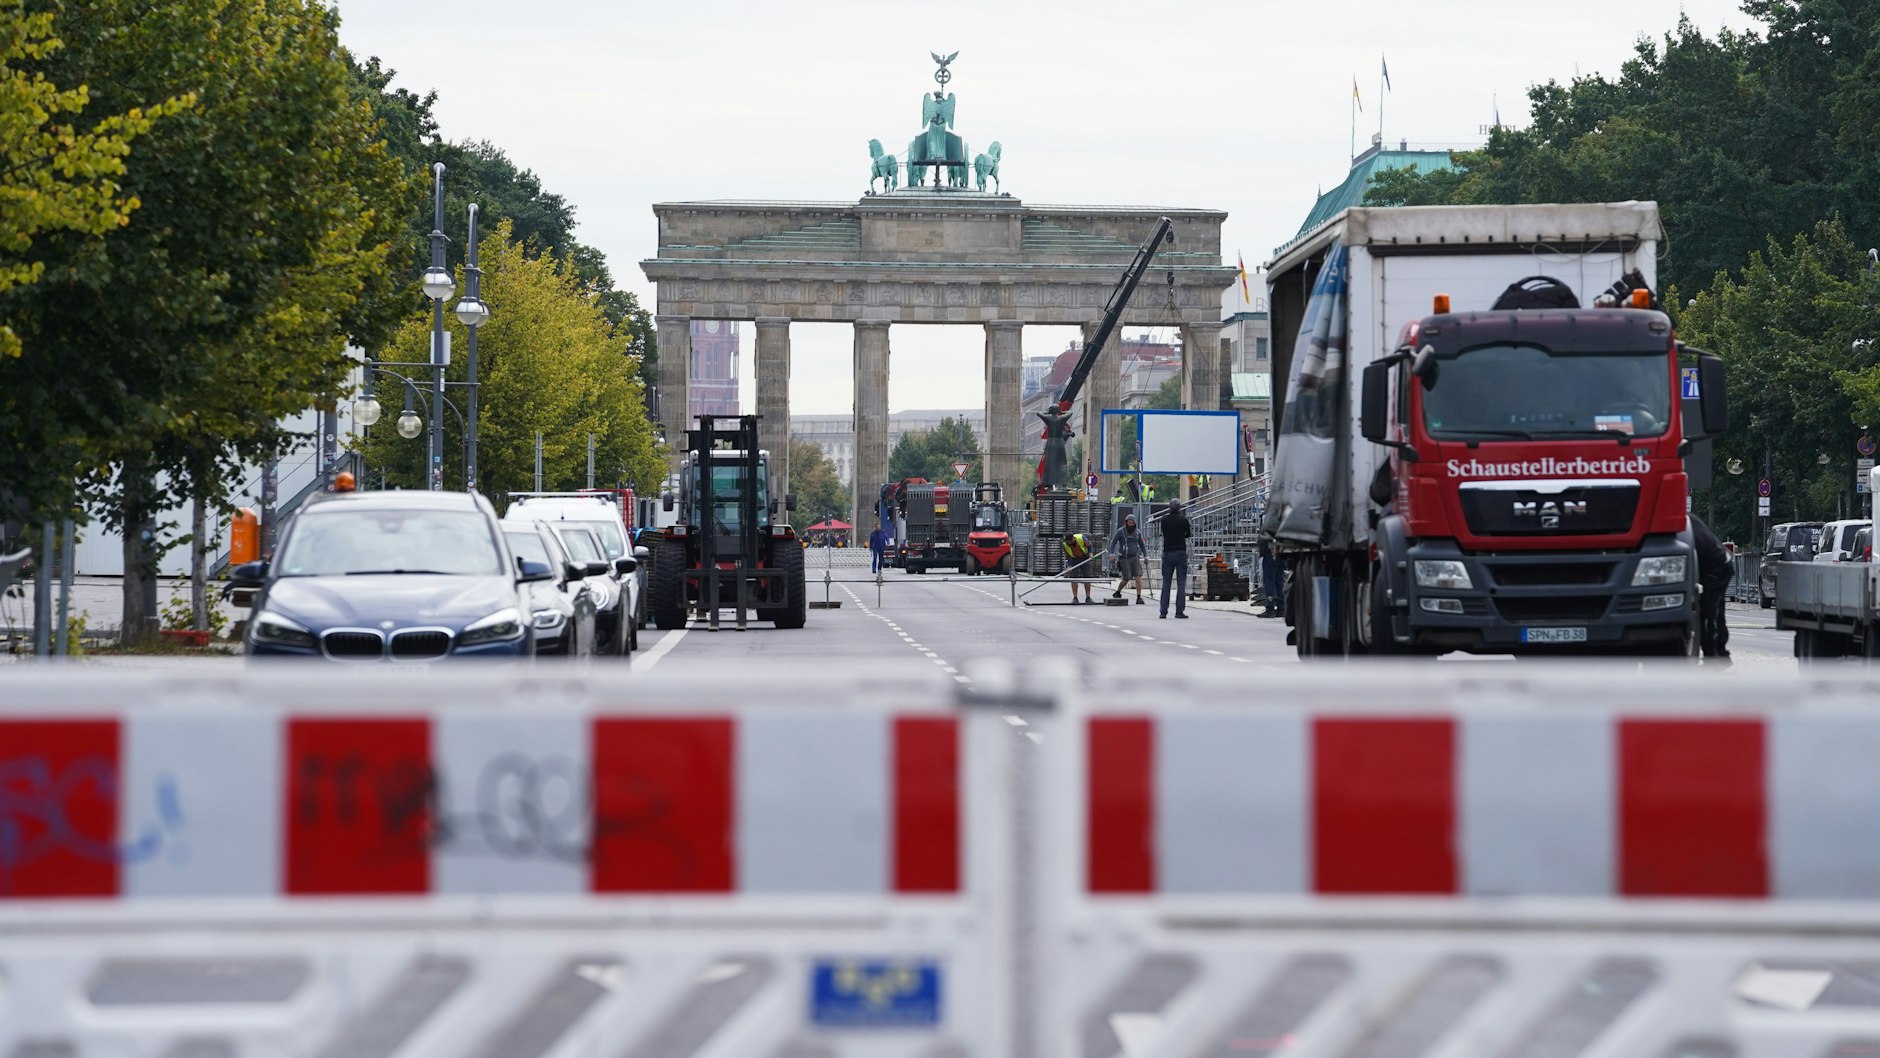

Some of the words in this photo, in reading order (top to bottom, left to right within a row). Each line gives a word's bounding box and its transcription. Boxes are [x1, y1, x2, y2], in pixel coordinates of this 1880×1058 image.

[1447, 456, 1651, 477] Schaustellerbetrieb
[1513, 501, 1587, 516] MAN
[1528, 629, 1550, 640] SPN
[1556, 629, 1570, 640] FB
[1572, 629, 1585, 640] 38
